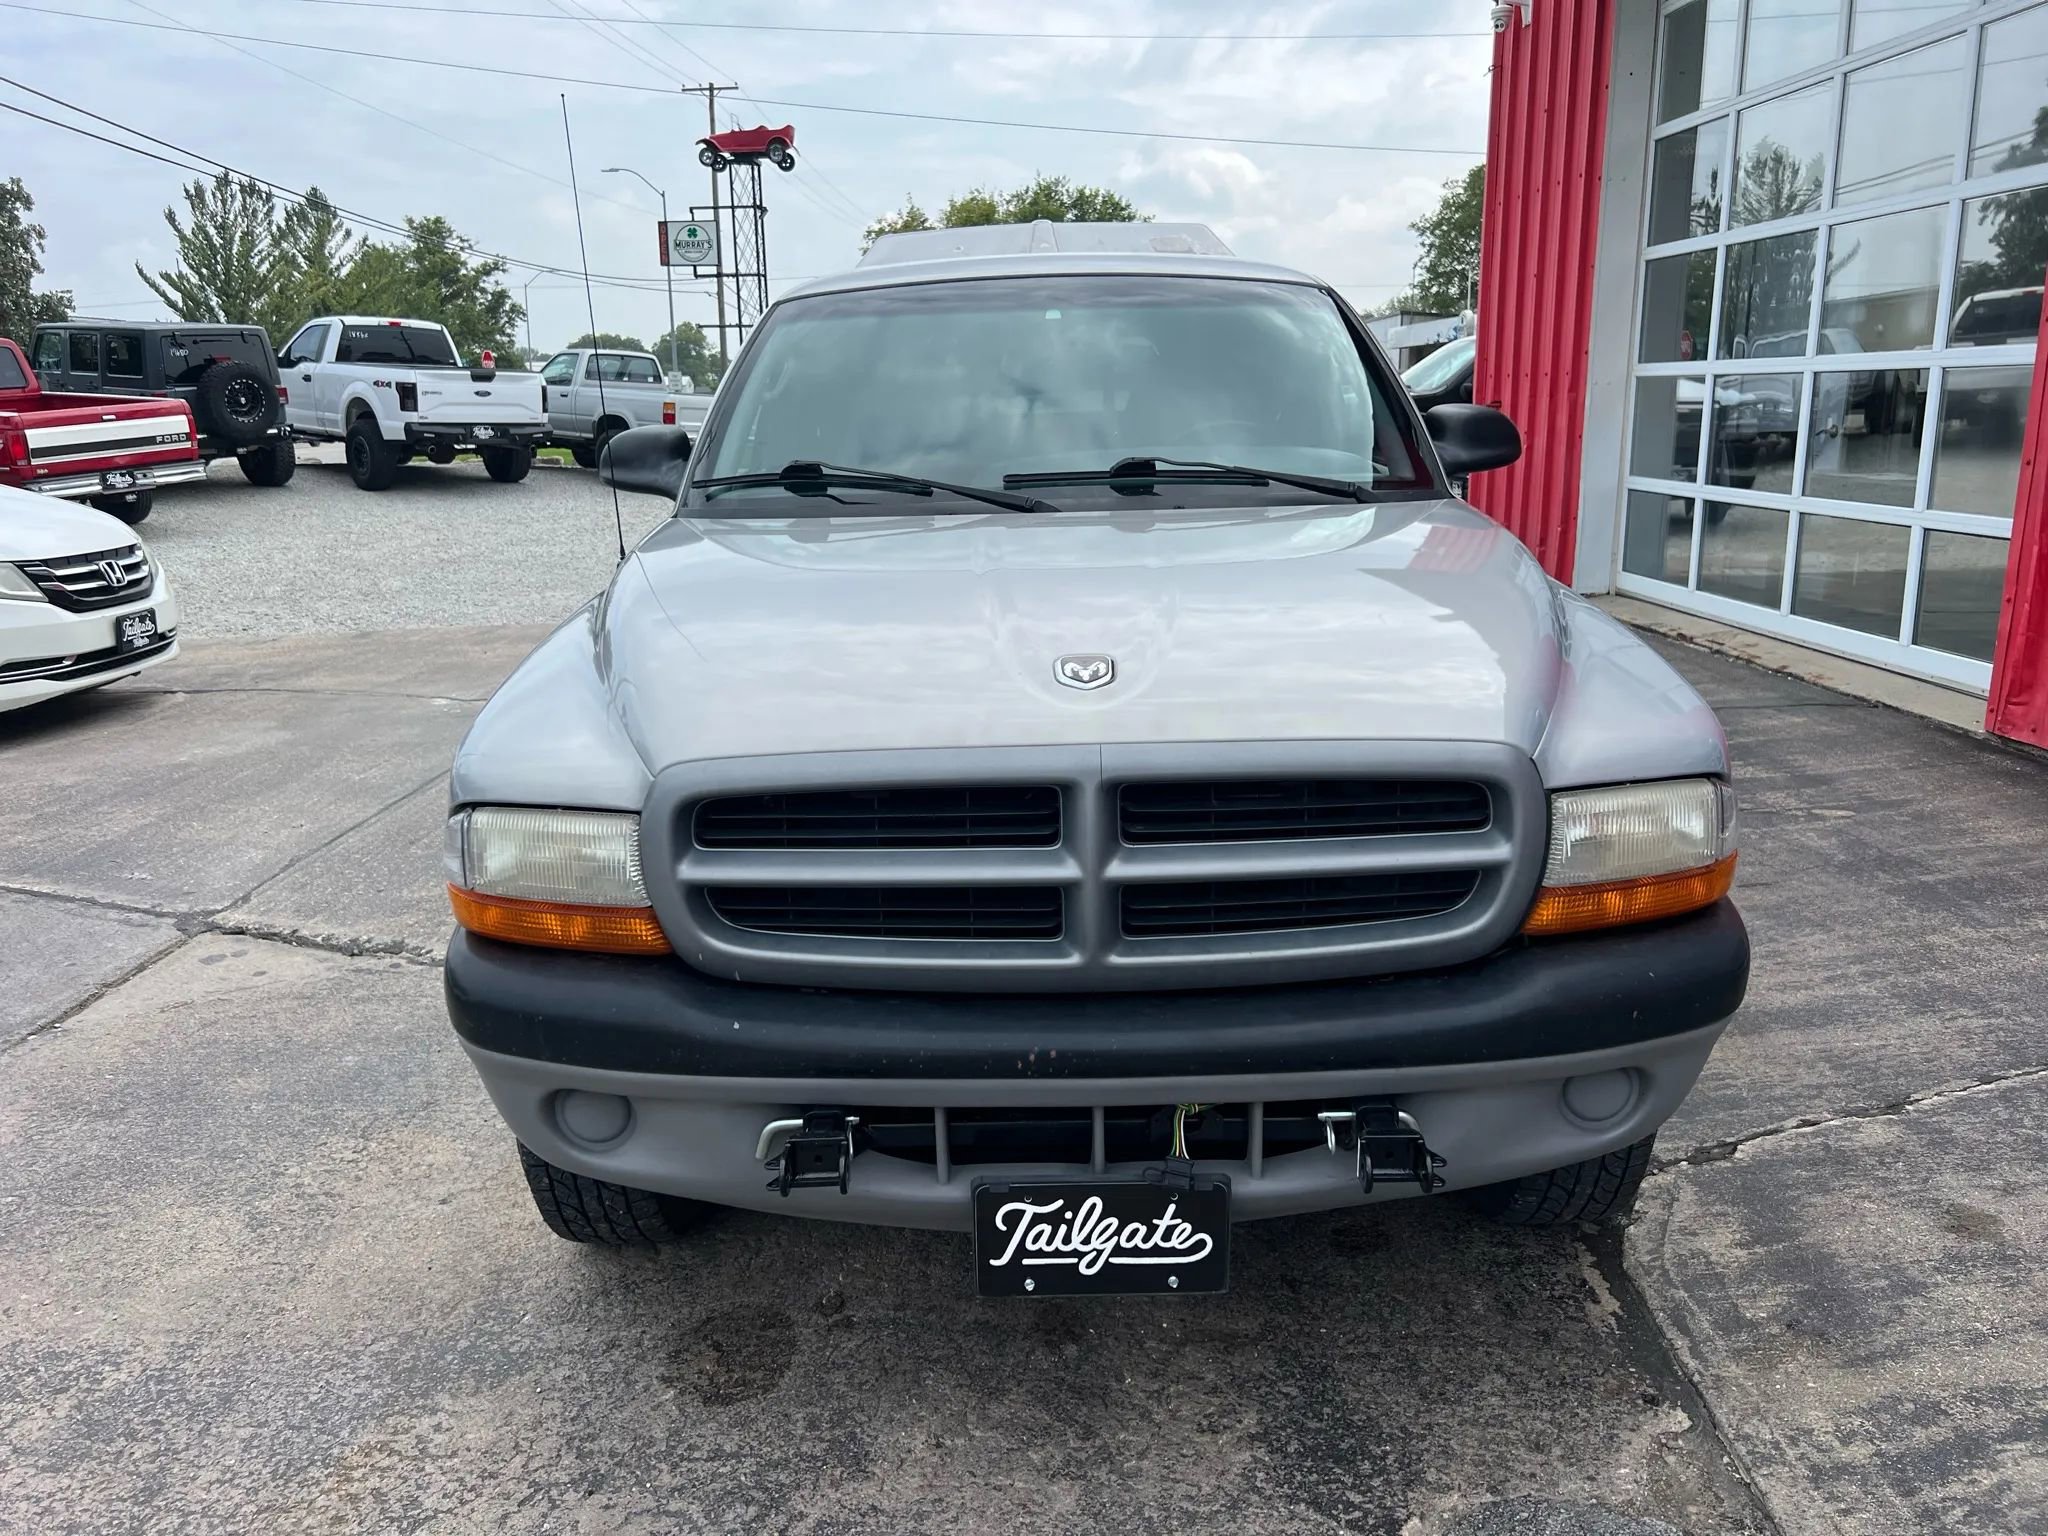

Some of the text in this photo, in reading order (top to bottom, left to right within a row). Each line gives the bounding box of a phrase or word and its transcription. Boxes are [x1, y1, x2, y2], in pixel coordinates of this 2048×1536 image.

[675, 241, 712, 249] MURRAY'S
[156, 434, 187, 444] FORD
[989, 1196, 1213, 1275] Tailgate
